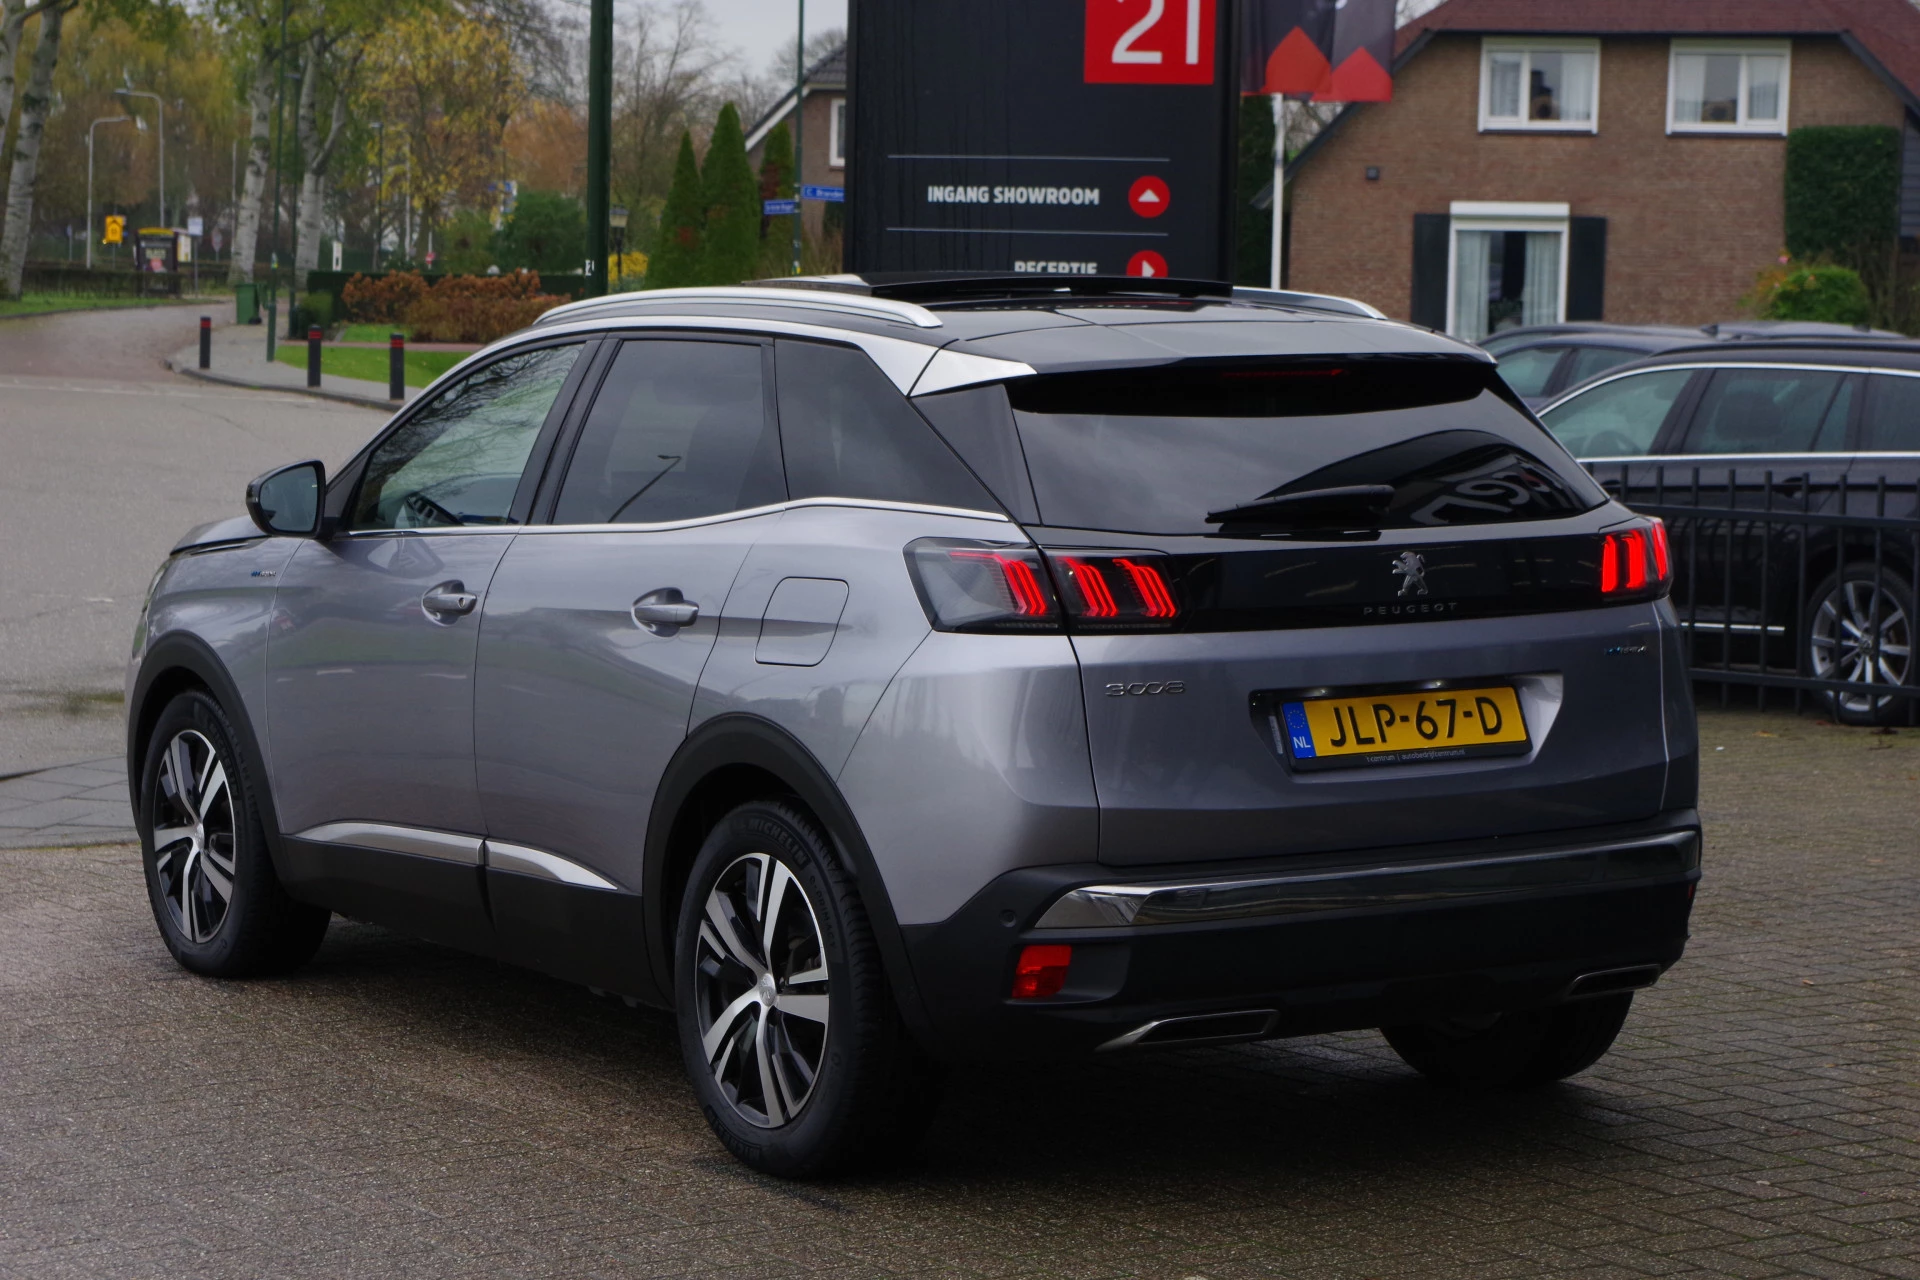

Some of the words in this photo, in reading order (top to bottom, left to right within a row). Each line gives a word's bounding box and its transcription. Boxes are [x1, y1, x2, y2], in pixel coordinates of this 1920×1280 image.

[1111, 0, 1201, 65] 21
[927, 185, 990, 205] INGANG
[994, 186, 1100, 206] SHOWROOM
[1363, 602, 1458, 616] PEUGEOT
[1104, 680, 1187, 696] 3008
[1329, 696, 1503, 748] JLP-67-D
[1292, 735, 1311, 750] NL
[746, 819, 809, 866] MICHELIN
